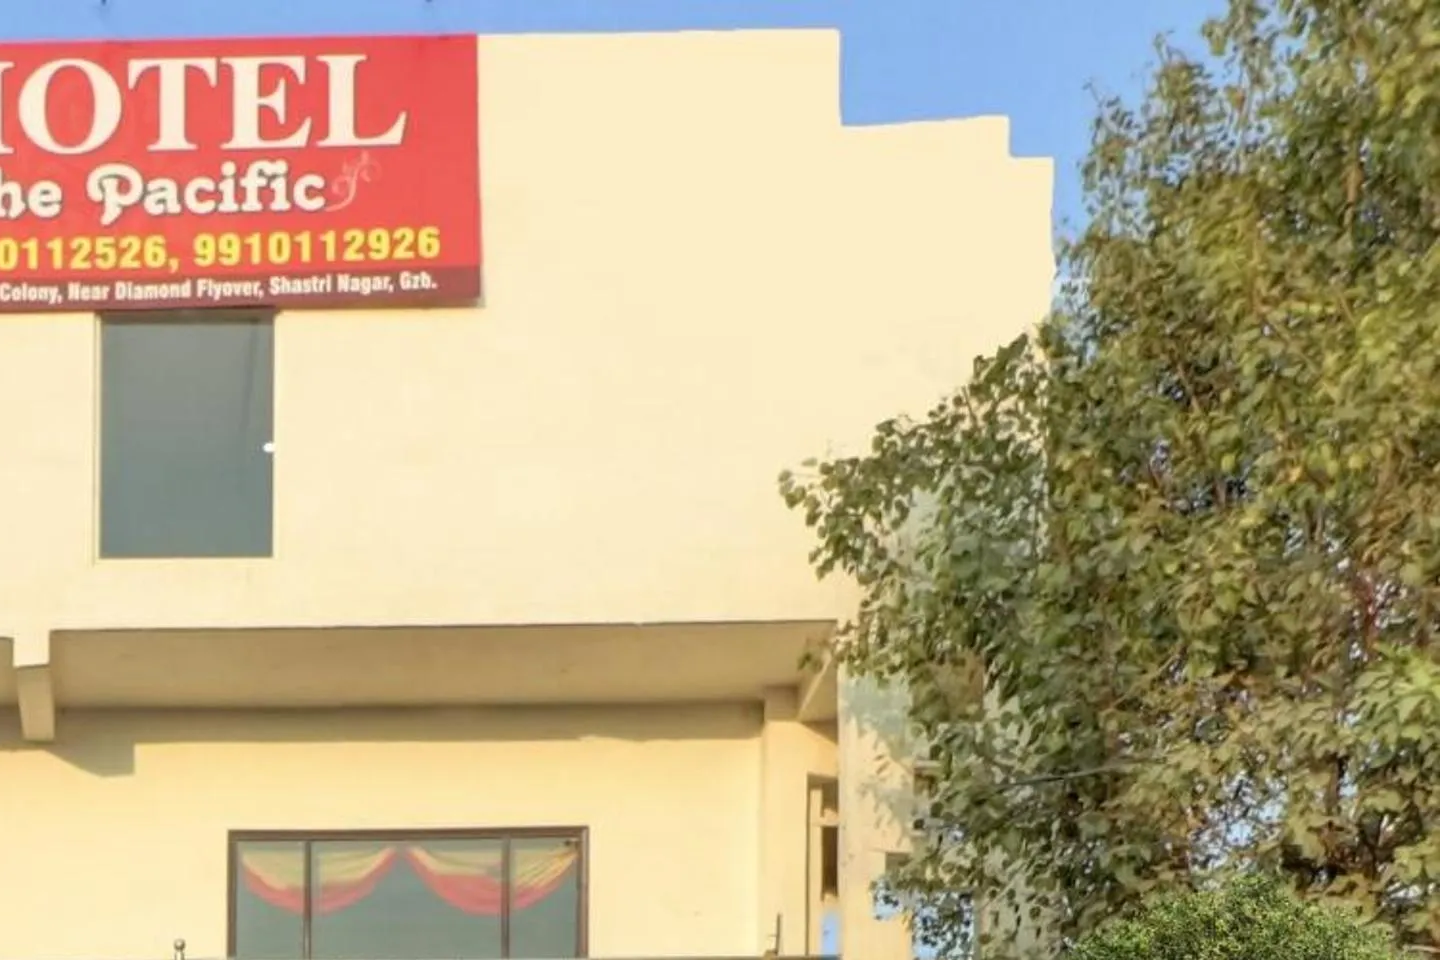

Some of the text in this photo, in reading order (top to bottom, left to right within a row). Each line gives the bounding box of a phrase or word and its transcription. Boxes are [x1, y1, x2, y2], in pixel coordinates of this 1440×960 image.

[87, 160, 326, 226] Pacific
[193, 226, 441, 266] 9910112926
[68, 281, 109, 300] Near
[115, 280, 191, 300] Diamond
[197, 279, 264, 299] Flyover,
[269, 275, 332, 295] Shastri
[337, 273, 394, 295] Nagar,
[399, 271, 438, 290] Gzb.
